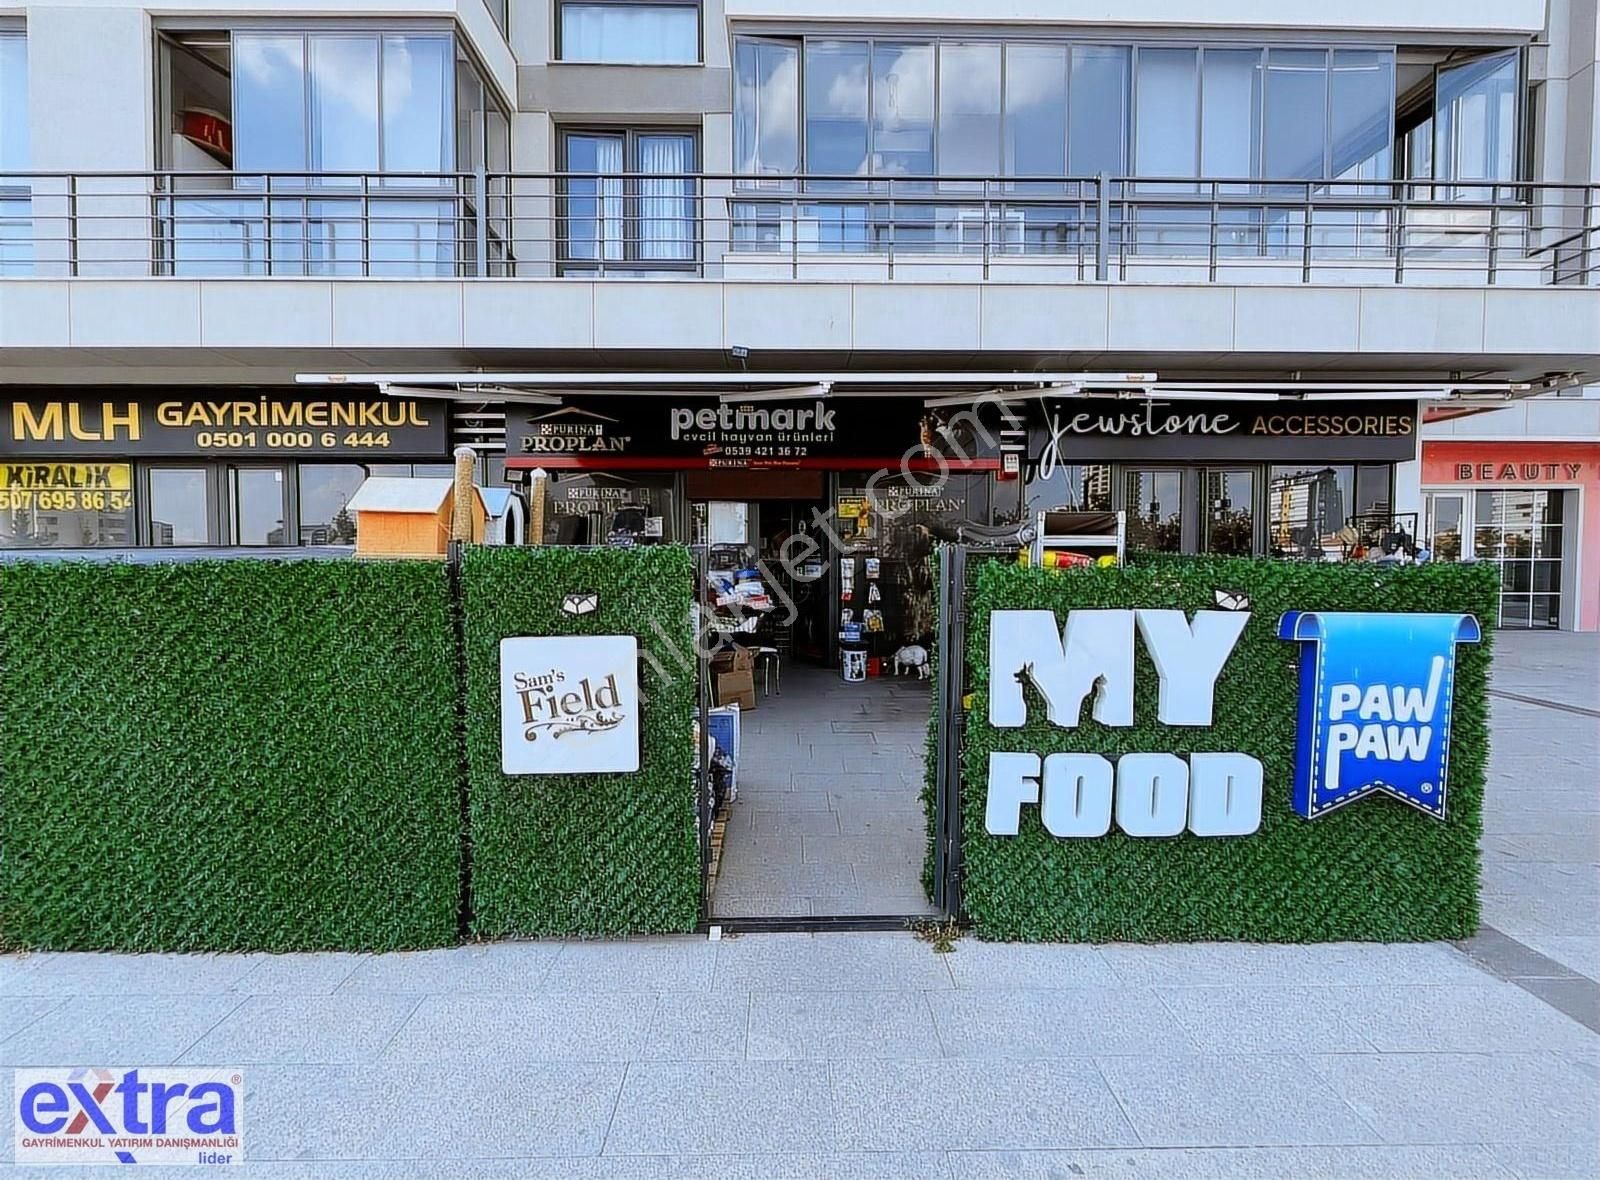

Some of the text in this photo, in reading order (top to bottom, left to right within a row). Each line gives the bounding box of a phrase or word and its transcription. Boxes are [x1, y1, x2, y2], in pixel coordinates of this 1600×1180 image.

[12, 395, 429, 441] MLH GAYRİMENKUL
[197, 431, 391, 448] 0501 000 6 444
[671, 401, 836, 440] petmark
[721, 432, 773, 444] hayvan
[1040, 398, 1413, 480] jewstone ACCESSORIES
[1459, 463, 1582, 480] BEAUTY
[39, 491, 77, 510] 695
[81, 491, 105, 510] 86
[513, 669, 566, 690] Sam's
[989, 608, 1251, 728] MY
[1329, 655, 1445, 723] PAW
[516, 674, 622, 724] Field
[1325, 723, 1432, 790] PAW
[985, 752, 1265, 838] FOOD
